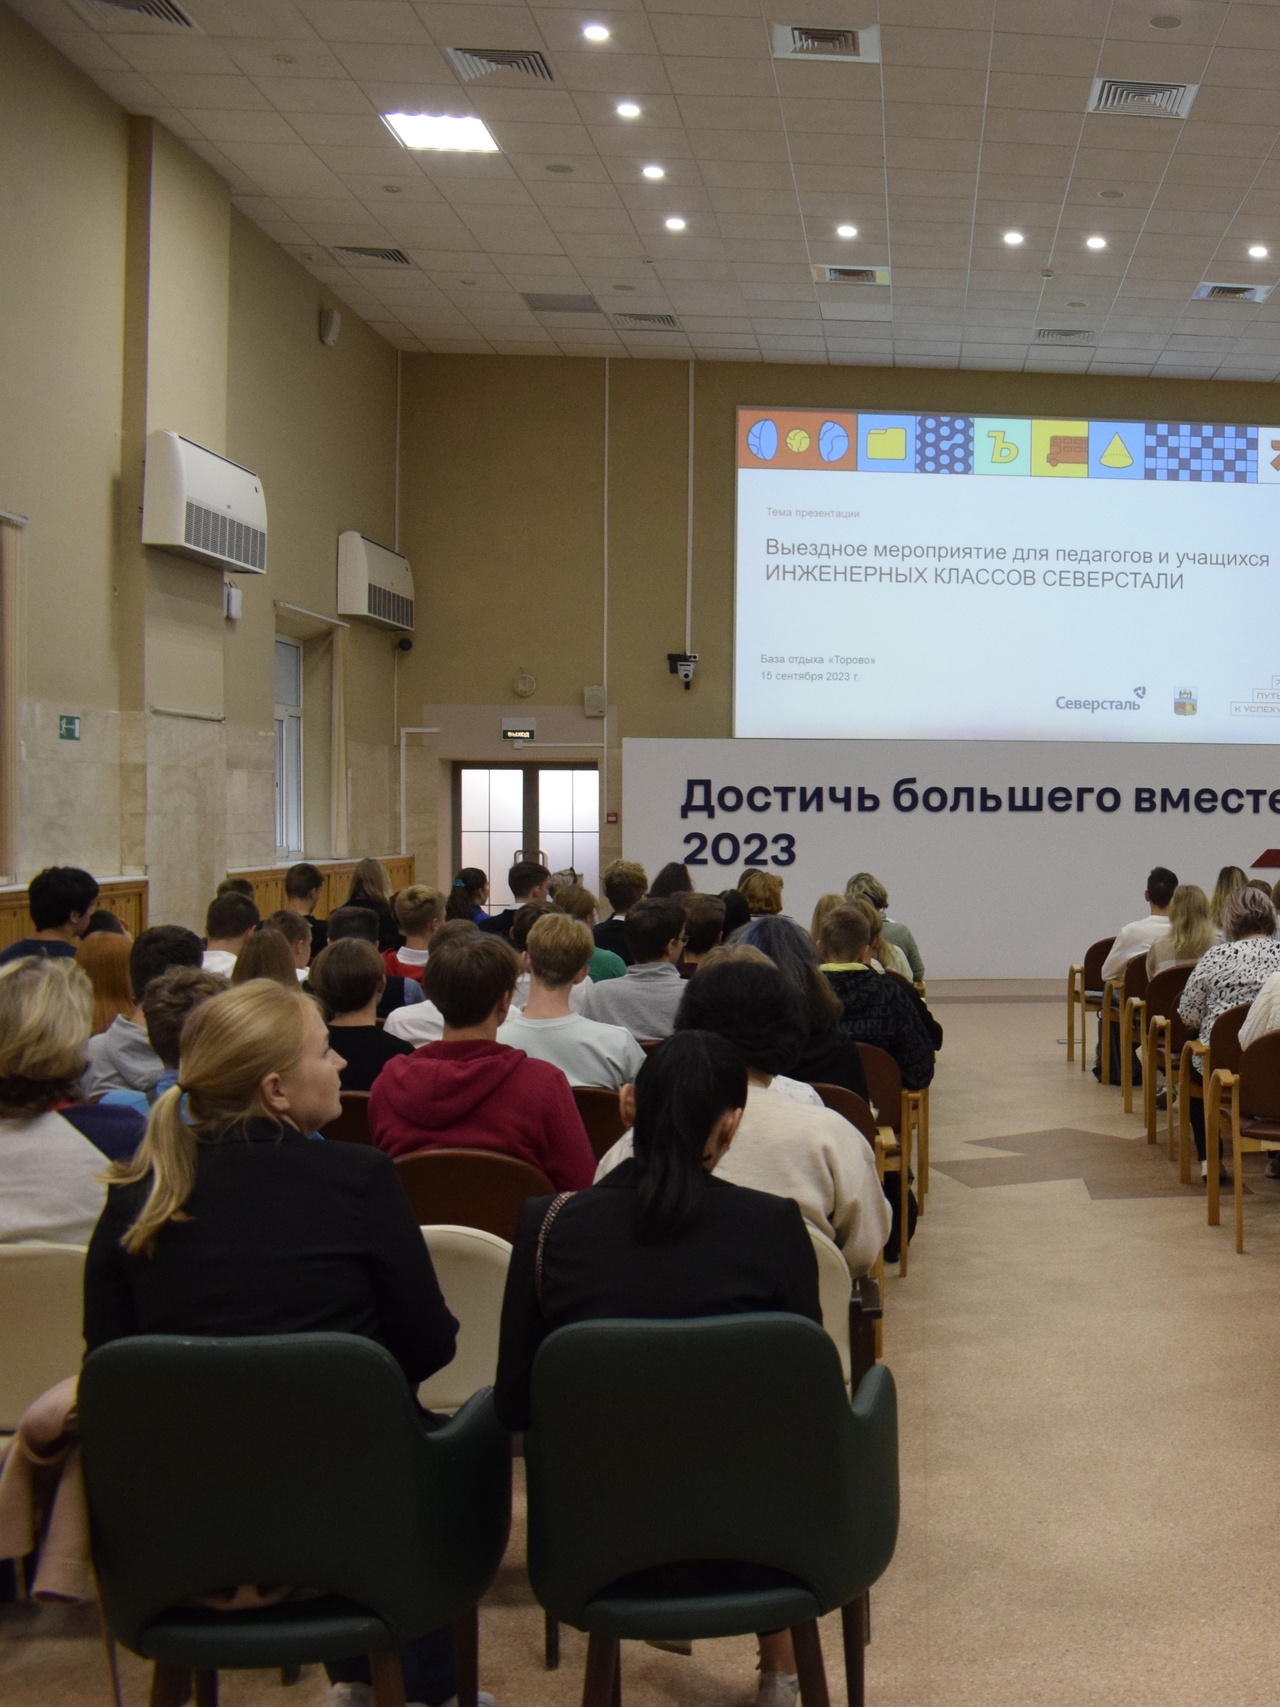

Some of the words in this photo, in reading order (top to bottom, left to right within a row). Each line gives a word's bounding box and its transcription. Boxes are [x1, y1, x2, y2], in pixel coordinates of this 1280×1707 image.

[766, 507, 792, 517] Тема
[795, 509, 860, 519] презентации
[766, 538, 868, 558] Выездное
[873, 543, 1007, 562] мероприятие
[1012, 547, 1049, 564] для
[1056, 548, 1153, 564] педагогов
[1159, 552, 1169, 564] и
[1176, 552, 1270, 568] учащихся
[765, 564, 928, 584] ИНЖЕНЕРНЫХ
[934, 567, 1036, 586] КЛАССОВ
[1043, 569, 1184, 589] СЕВЕРСТАЛИ
[760, 654, 785, 664] База
[788, 655, 824, 665] отдыха
[828, 655, 876, 666] «Торово»
[761, 671, 773, 680] 15
[775, 671, 823, 682] сентября
[826, 672, 850, 681] 2023
[853, 673, 860, 681] г.
[1055, 696, 1141, 713] Северсталь
[1234, 705, 1241, 713] К
[681, 778, 880, 818] Достичь
[893, 777, 1121, 813] большего
[683, 831, 797, 866] 2023
